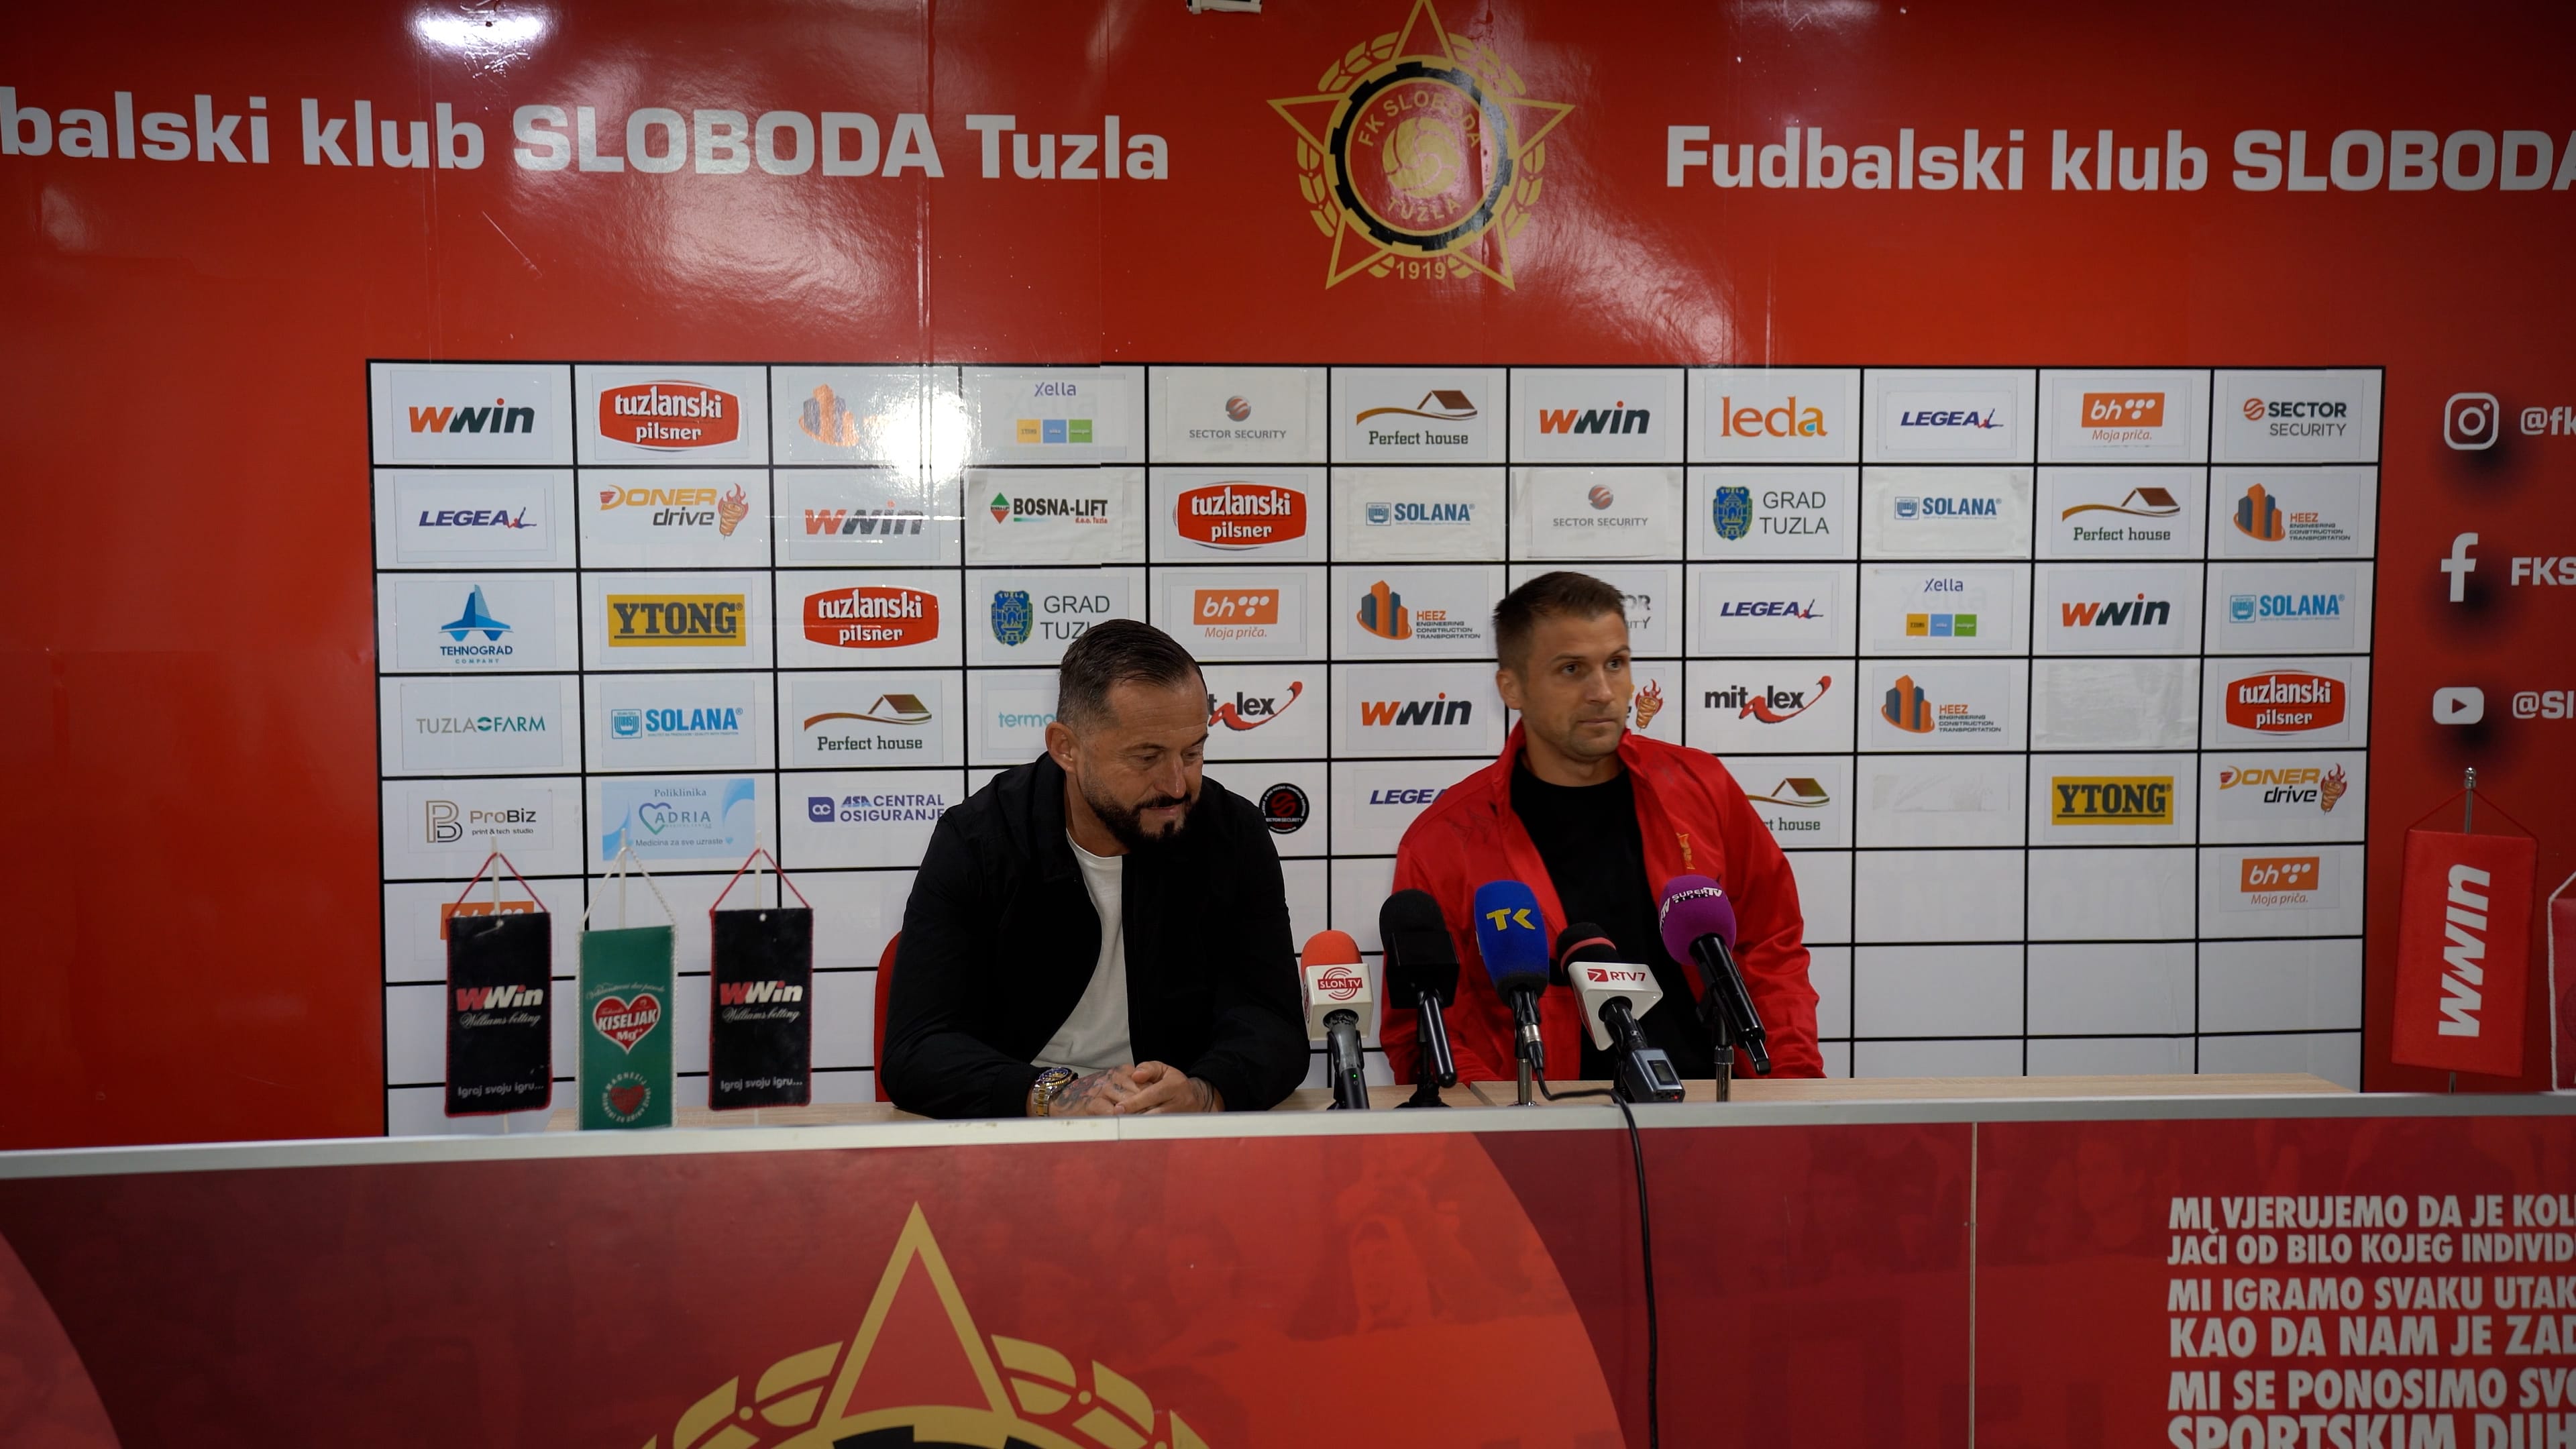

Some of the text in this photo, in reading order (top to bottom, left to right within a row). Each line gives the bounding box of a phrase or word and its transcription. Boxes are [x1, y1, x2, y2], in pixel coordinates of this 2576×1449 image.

[1358, 90, 1480, 147] FK SLOBODA
[0, 87, 1169, 180] balski klub SLOBODA Tuzla
[1666, 125, 2023, 191] Fudbalski
[2051, 130, 2208, 192] klub
[1387, 199, 1460, 221] TUZLA
[1397, 261, 1446, 279] 1919
[1034, 382, 1076, 397] Xella
[615, 386, 722, 419] tuzlanski
[2268, 402, 2347, 418] SECTOR
[1721, 396, 1828, 437] leda
[1900, 411, 1978, 426] LEGEA
[636, 423, 702, 443] pilsner
[1189, 430, 1286, 439] SECTOR SECURITY
[1369, 431, 1468, 445] Perfect house
[2092, 429, 2120, 441] Moja
[2270, 423, 2347, 437] SECURITY
[1014, 498, 1108, 516] BOSNA-LIFT
[1192, 487, 1291, 517] tuzlanski
[1763, 492, 1826, 509] GRAD
[419, 510, 510, 527] LEGEA
[653, 507, 714, 526] drive
[1553, 518, 1648, 527] SECTOR SECURITY
[2290, 513, 2318, 522] HEEZ
[1211, 523, 1272, 542] pilsner
[1760, 517, 1829, 535] TUZLA
[2074, 527, 2171, 541] Perfect house
[1924, 578, 1963, 592] Xella
[818, 590, 923, 620] tuzlanski
[1044, 596, 1110, 614] GRAD
[1721, 602, 1799, 616] LEGEA
[1416, 610, 1446, 621] HEEZ
[839, 625, 903, 645] pilsner
[1040, 621, 1089, 639] TUZ
[1205, 627, 1234, 639] Moja
[440, 645, 513, 656] TEHNOGRAD
[2239, 677, 2331, 705] tuzlanski
[1939, 705, 1968, 714] HEEZ
[2256, 710, 2312, 729] pilsner
[818, 736, 922, 751] Perfect house
[654, 789, 706, 797] Poliklinika
[874, 794, 945, 806] CENTRAL
[2264, 786, 2317, 803] drive
[470, 808, 536, 823] ProBiz
[655, 811, 711, 824] ADRIA
[1778, 818, 1820, 831] house
[2251, 894, 2277, 906] Moja
[1320, 980, 1346, 988] SLON
[1611, 972, 1646, 981] RTV7
[598, 1009, 657, 1031] KISELJAK
[458, 1085, 482, 1098] Igraj
[485, 1083, 512, 1095] svoju
[720, 1079, 743, 1092] Igraj
[745, 1077, 771, 1089] svoju
[2169, 1193, 2576, 1229] MI VJERUJEMO DA JE KOL
[2167, 1226, 2576, 1265] JAČI OD BILO KOJEG INDIVID
[2167, 1279, 2211, 1311] MI
[2223, 1277, 2364, 1310] IGRAMO
[2374, 1276, 2482, 1309] SVAKU
[2170, 1316, 2257, 1358] KAO
[2271, 1316, 2326, 1357] DA
[2340, 1316, 2438, 1356] NAM
[2451, 1315, 2491, 1356] JE
[2167, 1371, 2220, 1411] MI
[2233, 1370, 2275, 1409] SE
[2288, 1368, 2507, 1409] PONOSIMO
[2167, 1413, 2455, 1449] SPORTSKIM
